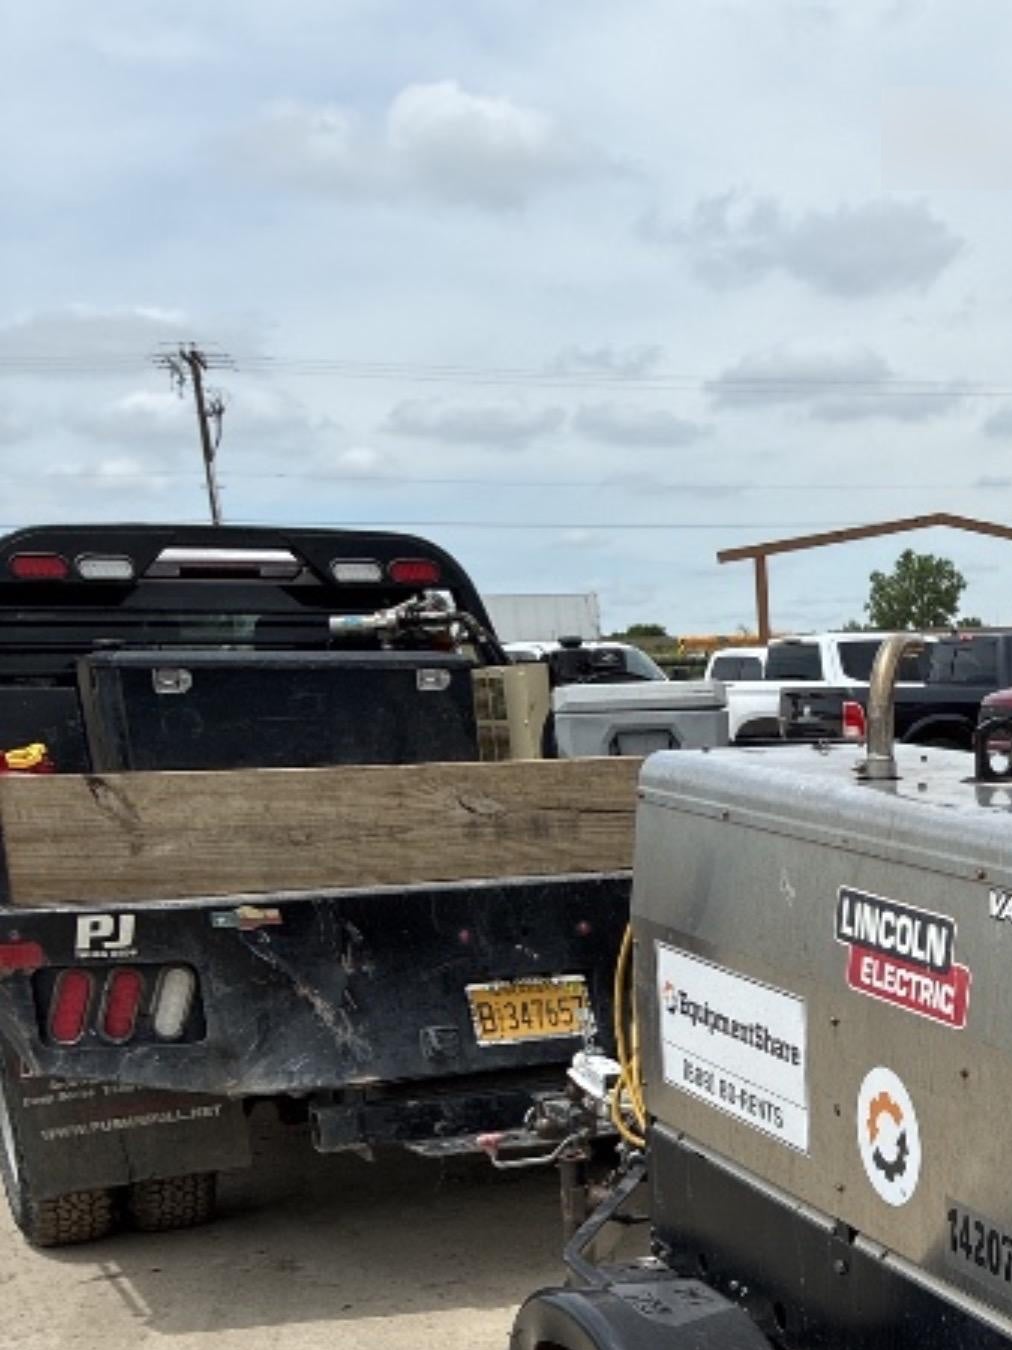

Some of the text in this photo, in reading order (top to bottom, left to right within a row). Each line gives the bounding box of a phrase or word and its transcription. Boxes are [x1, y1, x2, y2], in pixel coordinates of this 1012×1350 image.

[76, 914, 136, 949] PJ
[841, 896, 949, 968] LINCOLN
[860, 956, 956, 1015] ELECTRIC
[677, 989, 802, 1066] EquipmentShare
